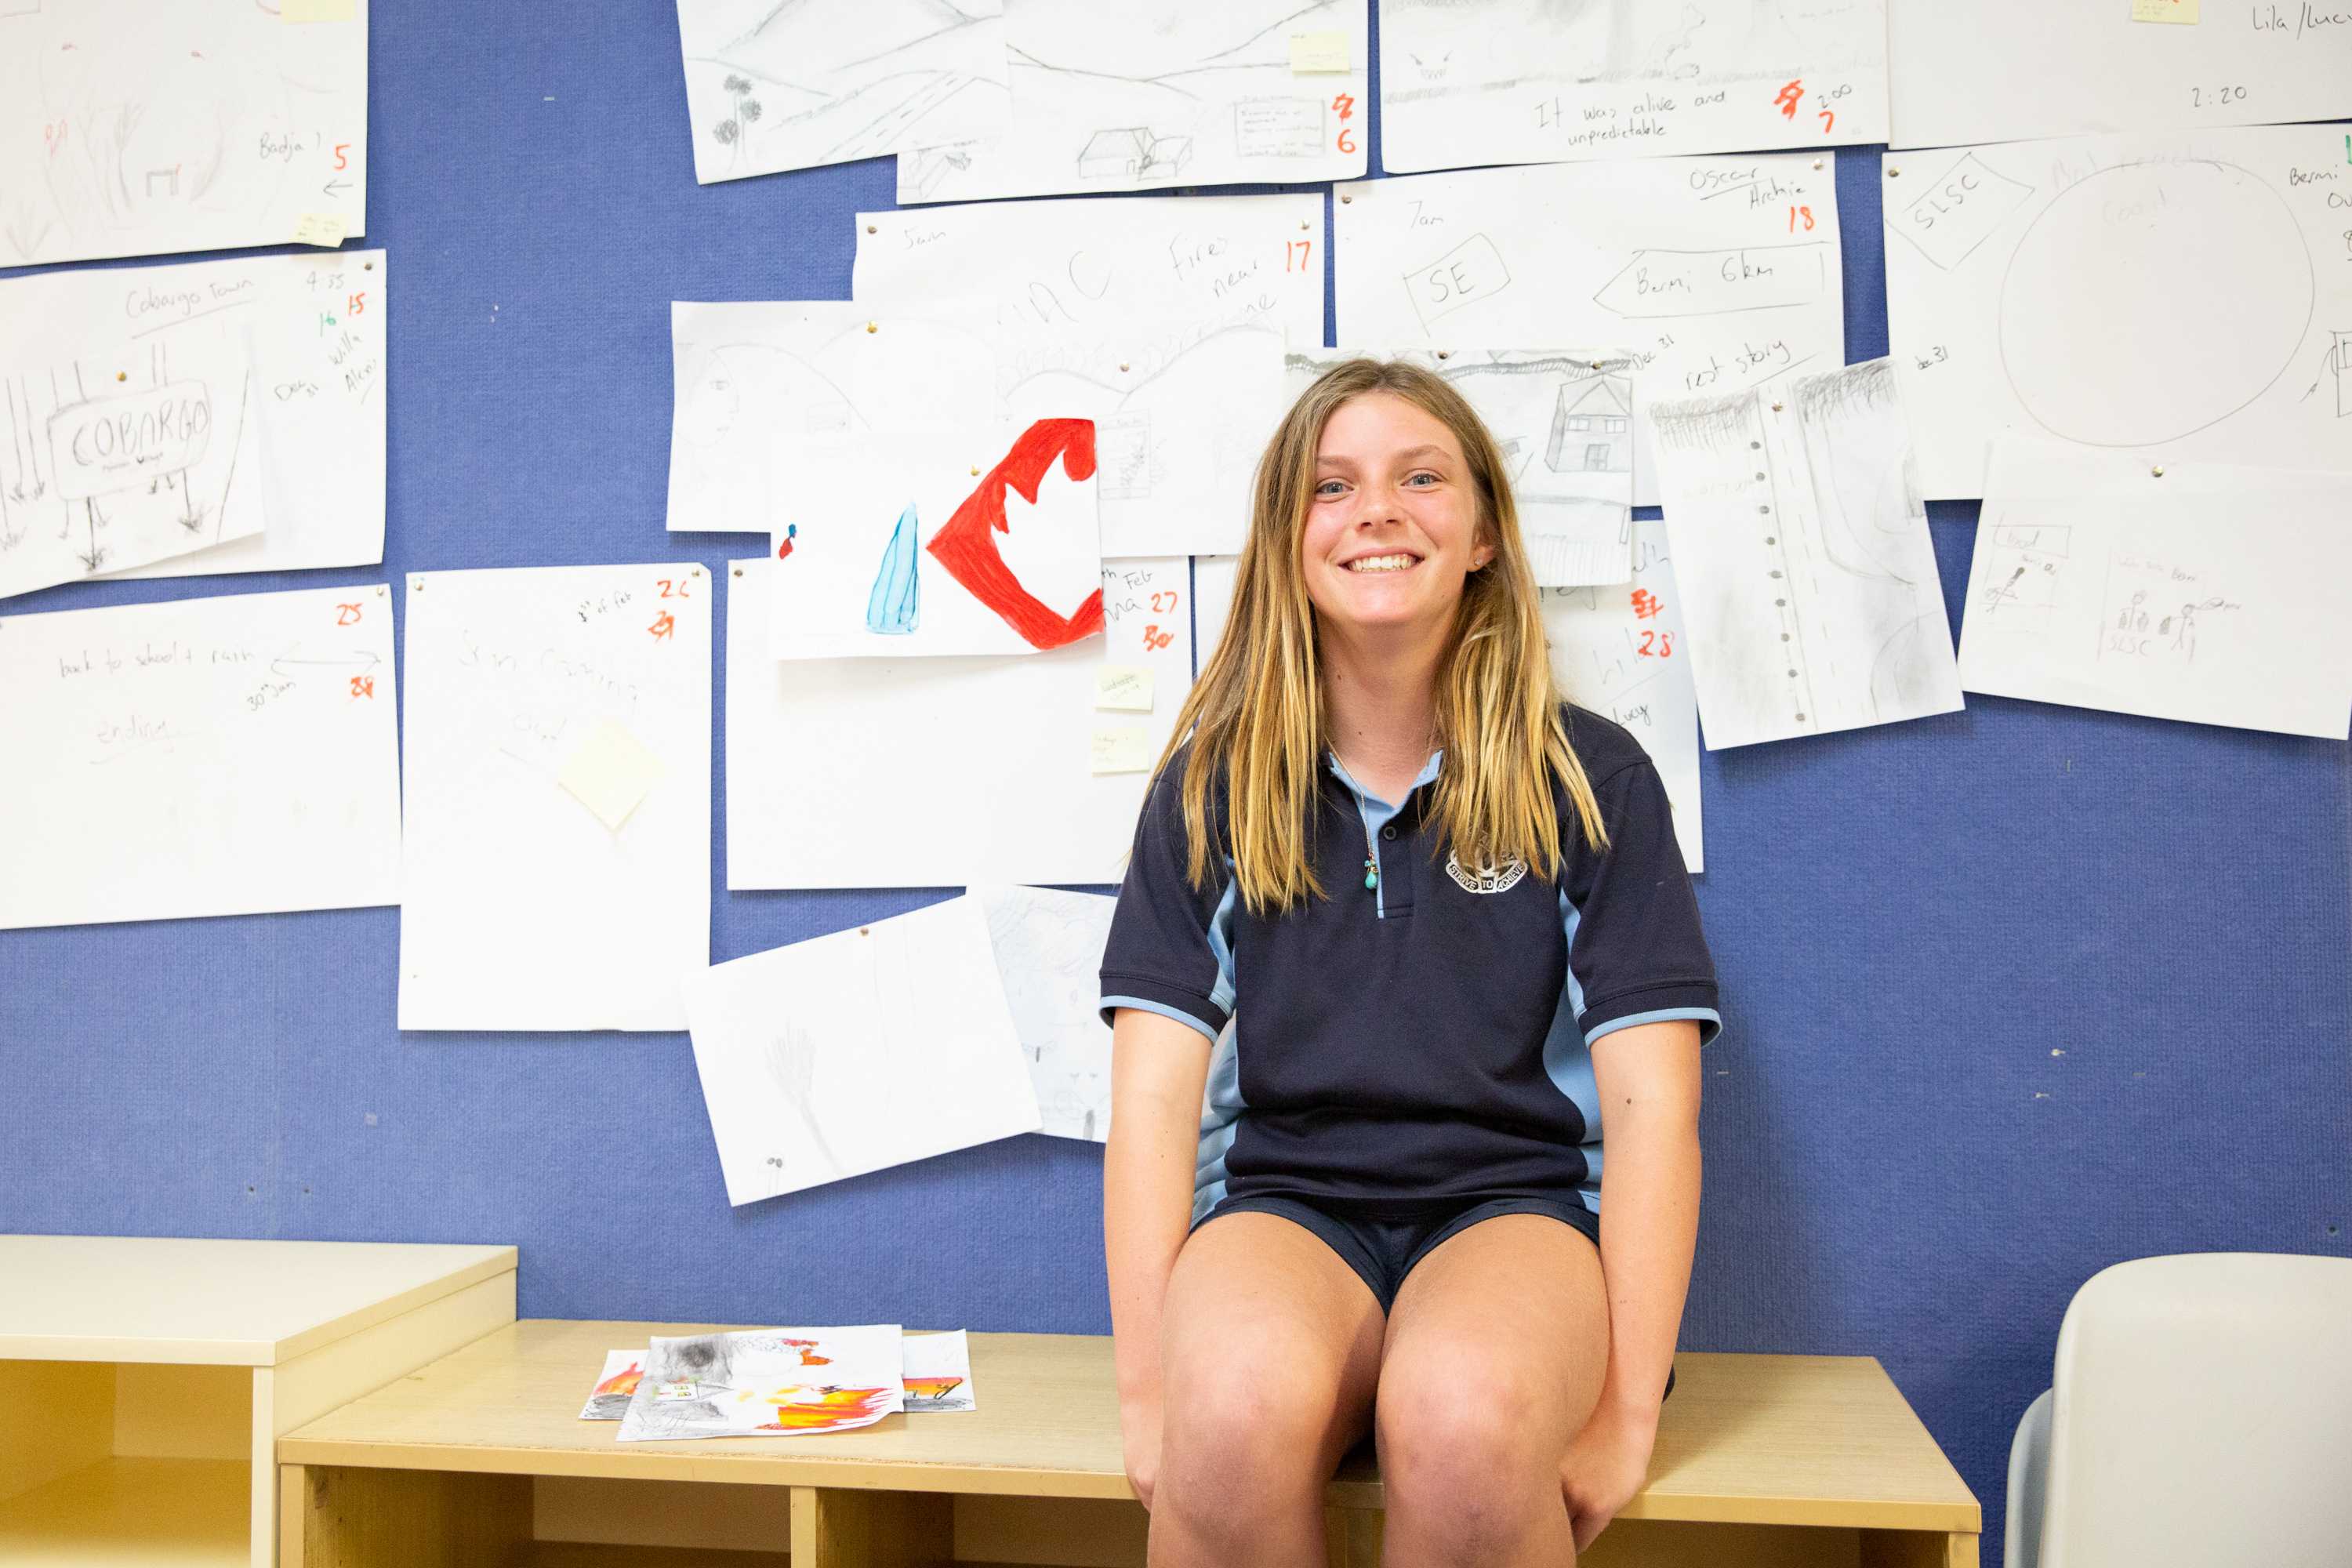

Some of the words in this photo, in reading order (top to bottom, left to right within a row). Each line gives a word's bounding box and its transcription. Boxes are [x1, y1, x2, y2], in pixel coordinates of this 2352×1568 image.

[2252, 5, 2289, 31] Lila
[1534, 96, 1563, 128] It
[1633, 92, 1677, 114] alive
[1694, 90, 1726, 107] and
[2191, 86, 2248, 108] 2:20
[1818, 110, 1835, 134] 7
[1336, 128, 1356, 154] 6
[333, 143, 352, 171] 5
[1690, 166, 1759, 191] Oscar
[1750, 177, 1806, 210] Archie
[1915, 174, 1980, 230] SLSC
[1789, 205, 1815, 234] 18
[1286, 239, 1312, 274] 17
[1429, 260, 1476, 303] SE
[125, 285, 201, 319] Cobargo
[209, 279, 255, 300] Town
[348, 292, 366, 317] 15
[1735, 340, 1791, 375] story
[72, 397, 211, 466] COBARGO
[1123, 568, 1154, 590] Feb
[1151, 590, 1178, 614] 27
[1637, 629, 1676, 659] 28
[1448, 863, 1479, 891] STRIVE
[1481, 879, 1494, 890] TO
[1496, 862, 1526, 890] ACHIEVE
